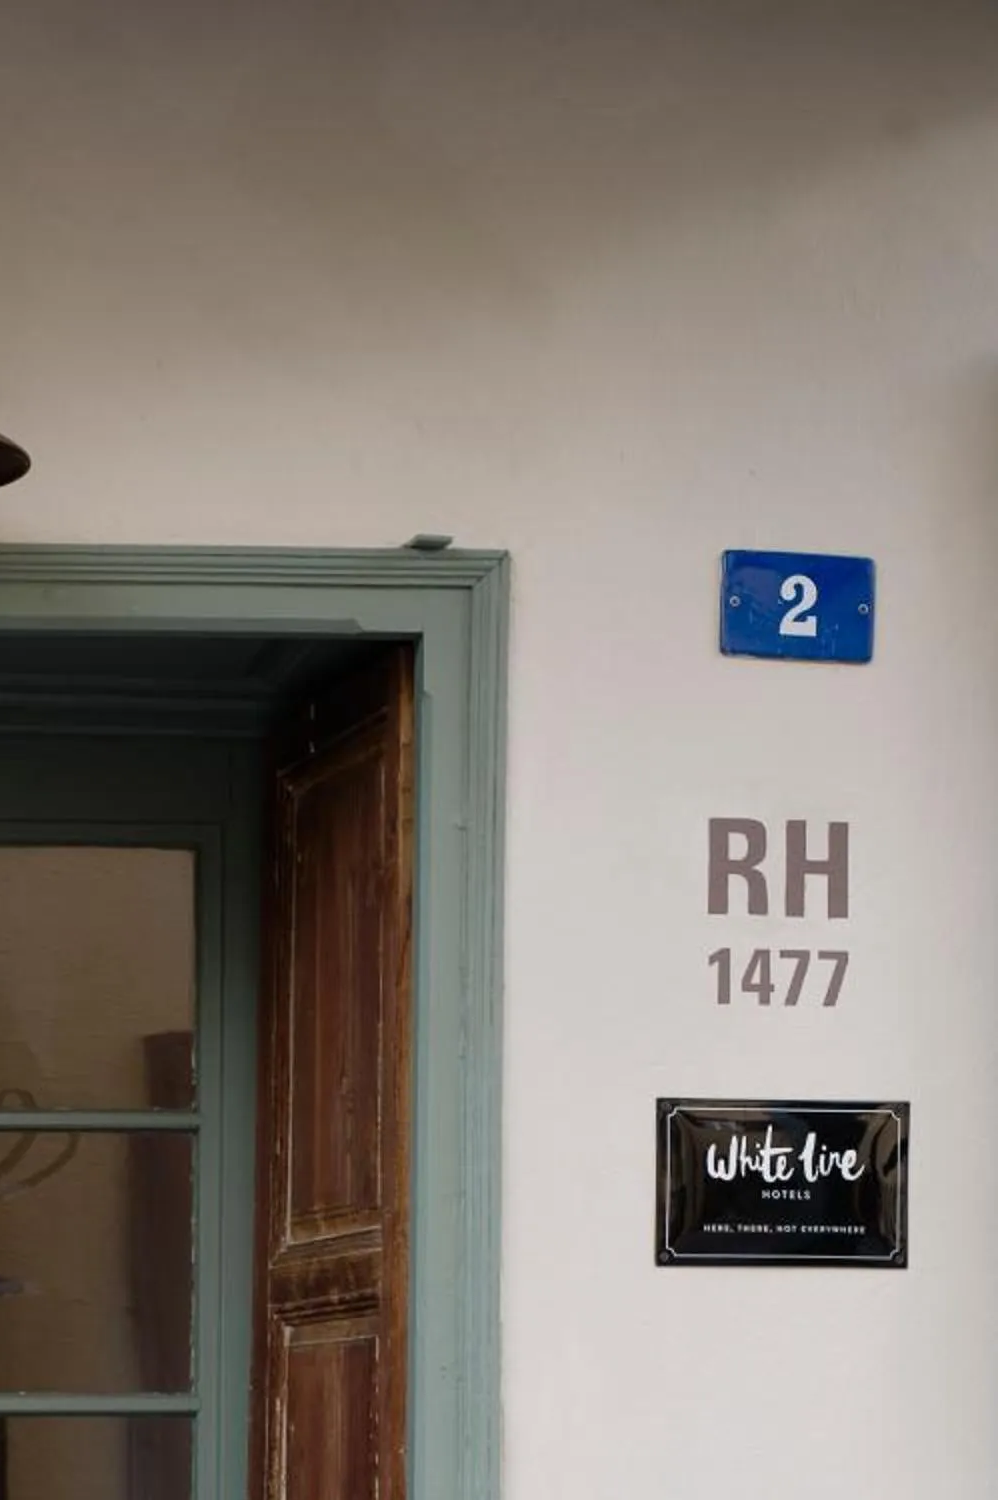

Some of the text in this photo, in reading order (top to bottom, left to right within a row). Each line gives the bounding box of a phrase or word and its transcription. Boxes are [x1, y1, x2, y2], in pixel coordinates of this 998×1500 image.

[779, 575, 818, 637] 2
[707, 817, 850, 920] RH
[707, 947, 850, 1008] 1477
[706, 1124, 795, 1183] White
[761, 1189, 811, 1200] HOTELS
[703, 1223, 866, 1235] HERE, THERE, NOT EVERYWHERE
